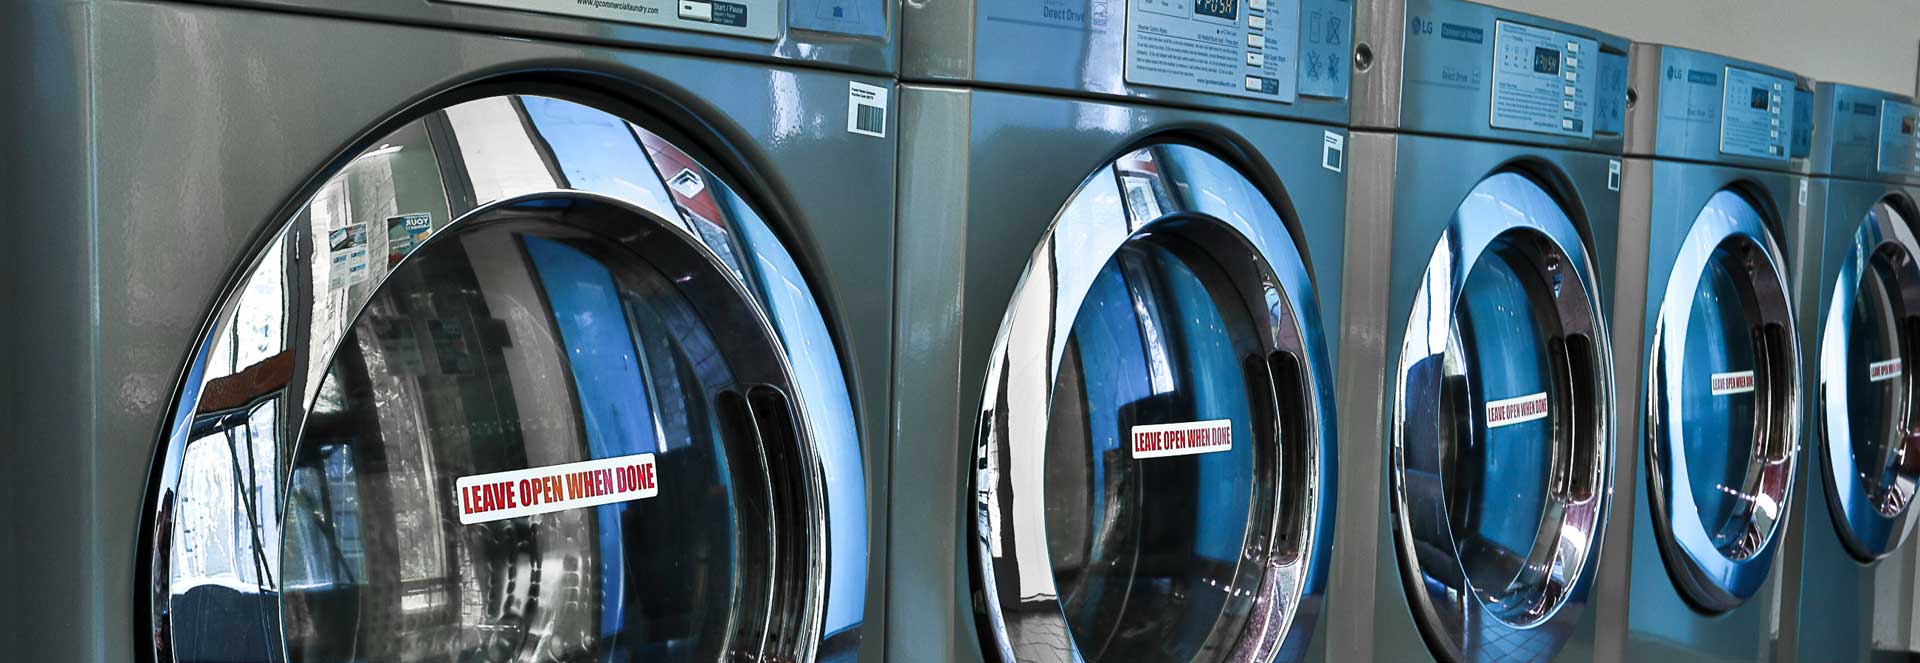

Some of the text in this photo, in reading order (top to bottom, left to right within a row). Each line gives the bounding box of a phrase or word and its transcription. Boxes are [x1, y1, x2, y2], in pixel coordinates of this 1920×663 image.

[1043, 6, 1086, 22] Direct Drive
[1488, 398, 1546, 422] LEAVE OPEN WHEN DONE
[1135, 426, 1230, 452] LEAVE OPEN WHEN DONE
[462, 463, 655, 514] LEAVE OPEN WHEN DONE
